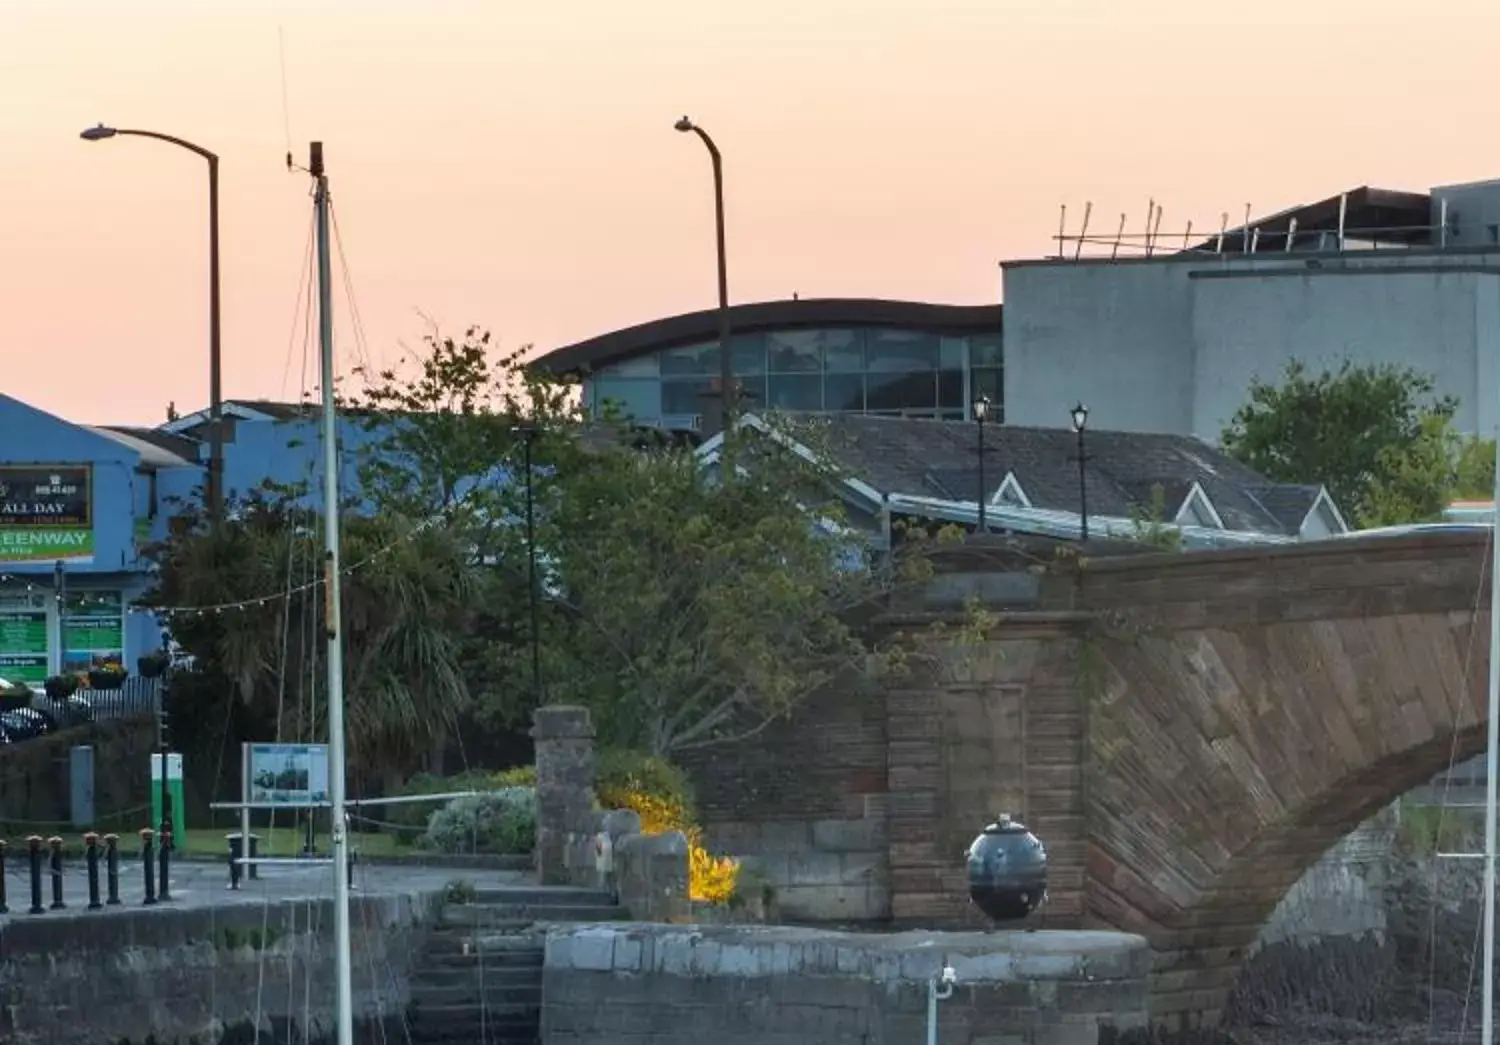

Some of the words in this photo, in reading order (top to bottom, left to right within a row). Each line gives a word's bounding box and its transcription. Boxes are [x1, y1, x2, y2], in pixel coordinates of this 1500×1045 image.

[2, 503, 30, 513] ALL
[34, 503, 65, 513] DAY
[0, 531, 87, 545] EENWAY
